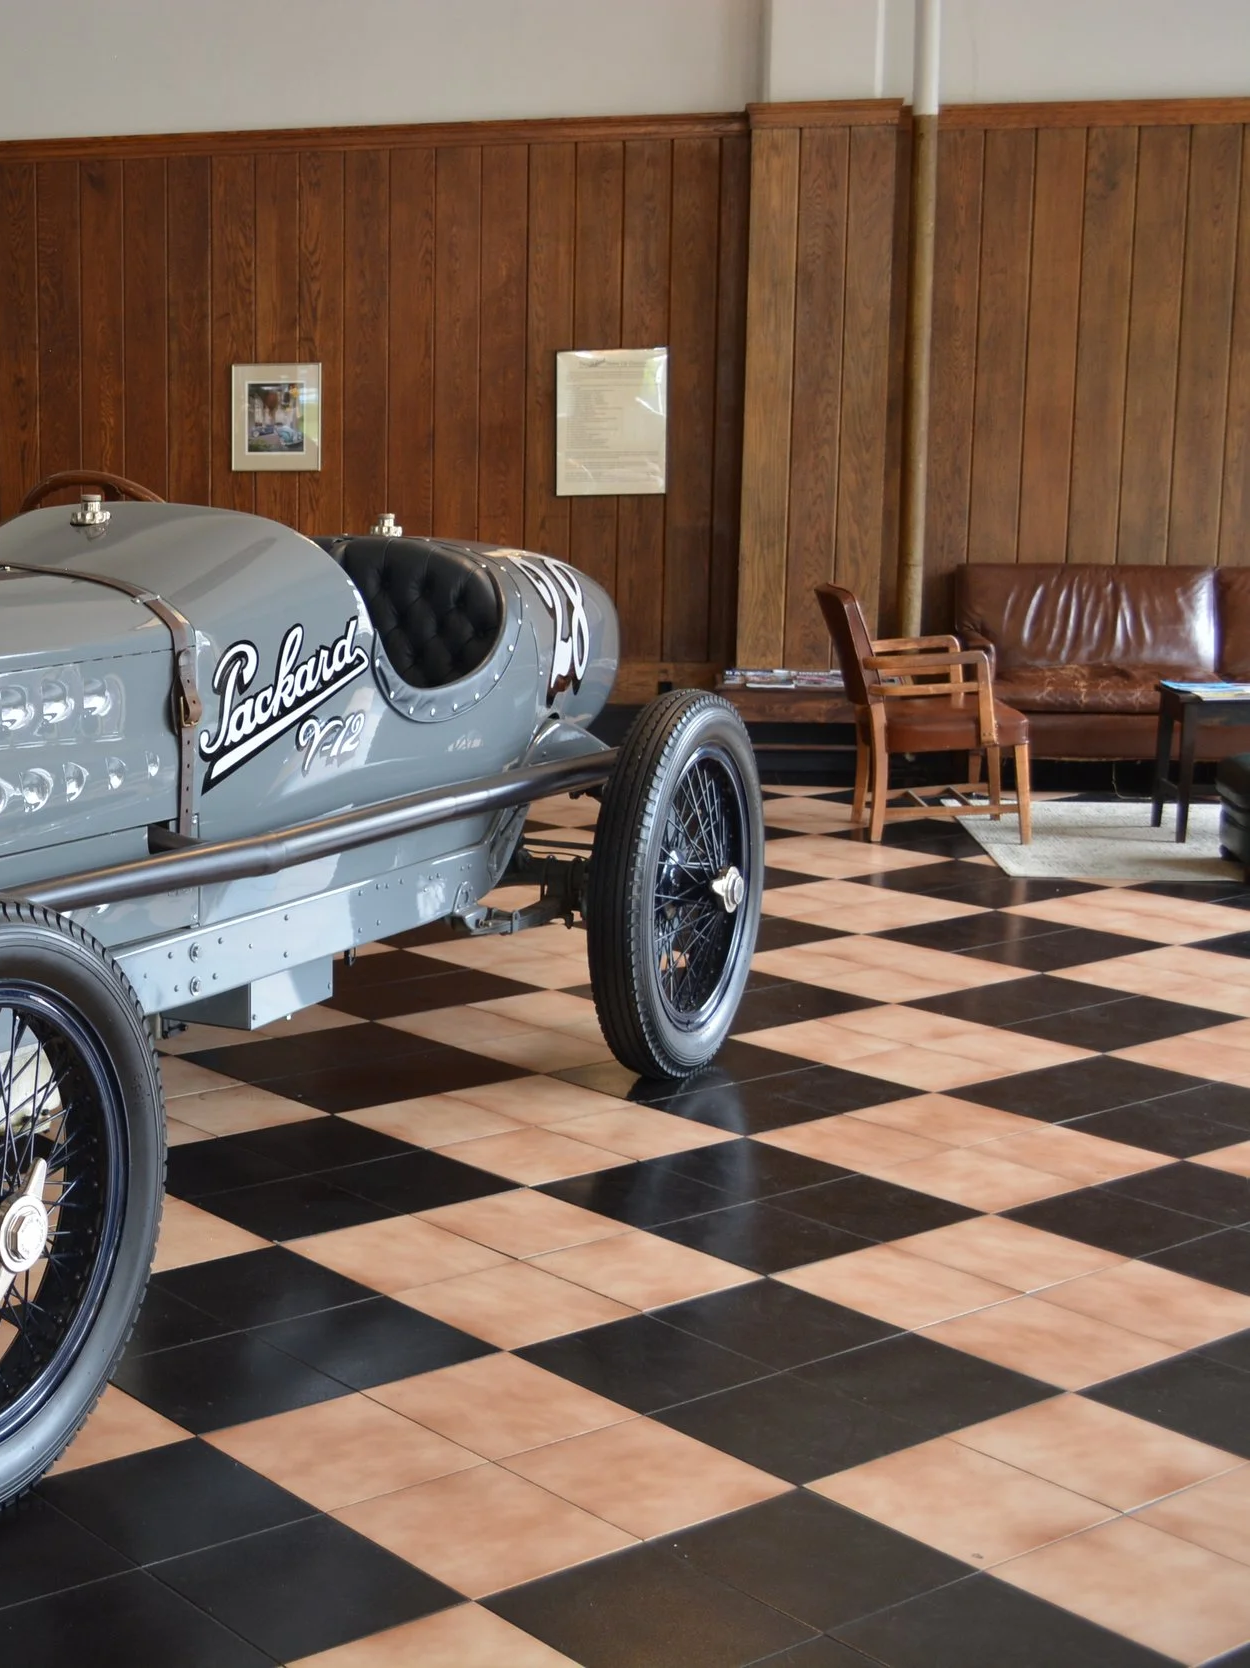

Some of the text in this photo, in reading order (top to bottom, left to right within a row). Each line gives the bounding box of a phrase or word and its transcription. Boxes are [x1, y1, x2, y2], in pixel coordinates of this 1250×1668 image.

[199, 615, 369, 764] Packard
[506, 554, 590, 690] 28
[296, 711, 366, 777] V-12
